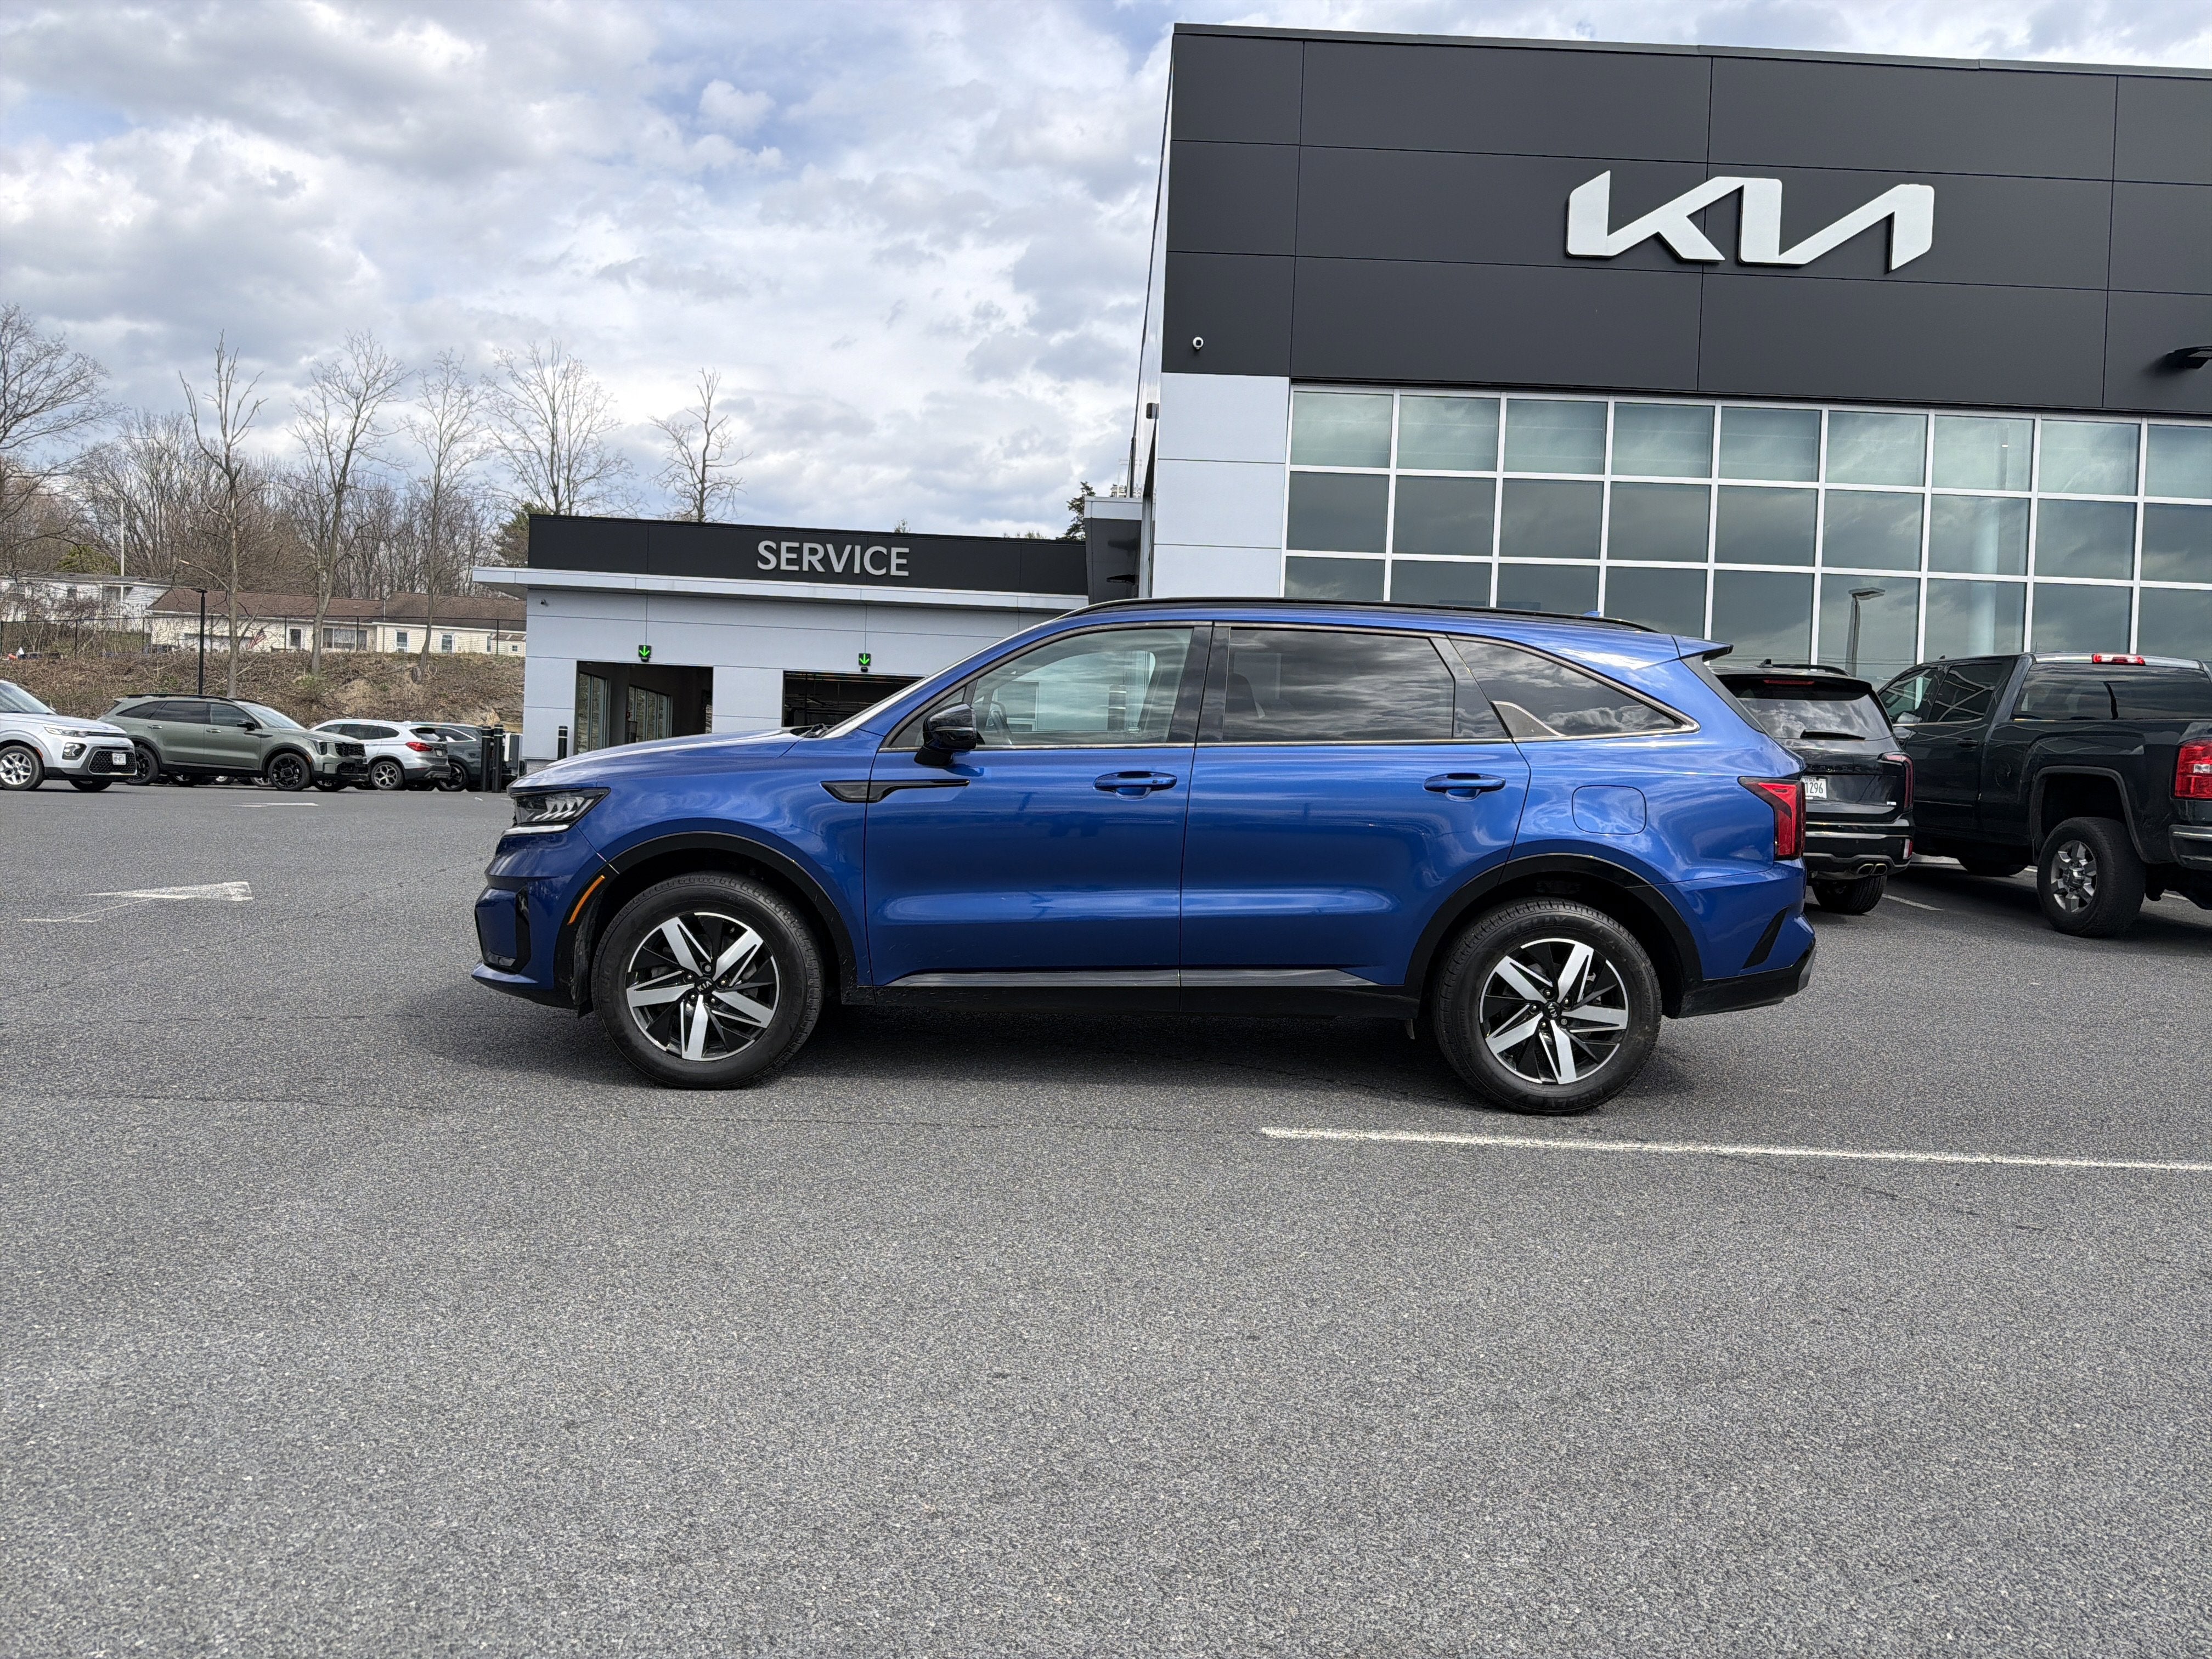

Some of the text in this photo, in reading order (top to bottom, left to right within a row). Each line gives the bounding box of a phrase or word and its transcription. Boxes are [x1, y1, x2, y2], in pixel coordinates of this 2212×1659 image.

[1566, 170, 1934, 271] KIA
[757, 540, 910, 576] SERVICE
[1805, 782, 1824, 794] 1296
[697, 980, 713, 991] KIA
[1548, 1003, 1558, 1018] KIA
